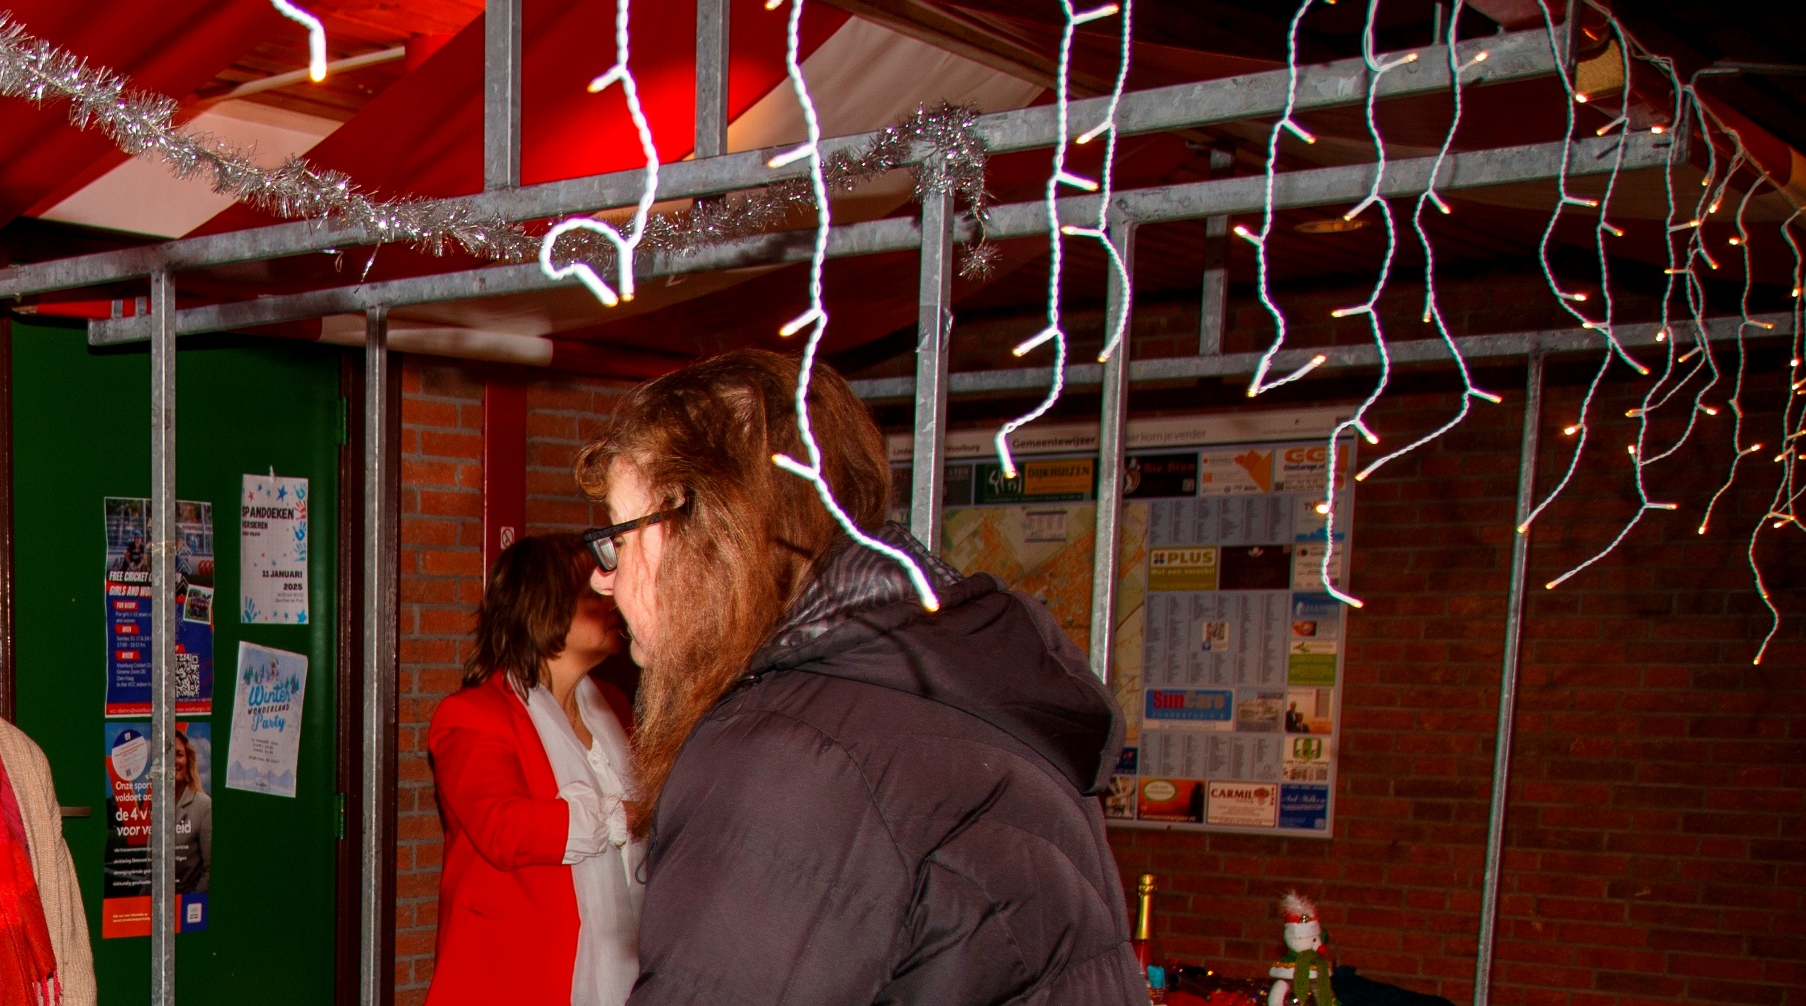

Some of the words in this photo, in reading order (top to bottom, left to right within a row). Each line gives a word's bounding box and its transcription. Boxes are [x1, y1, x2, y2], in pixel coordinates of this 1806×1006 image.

[1167, 551, 1213, 564] PLUS
[109, 570, 124, 581] FREE
[124, 571, 147, 582] CRICKET
[270, 570, 303, 578] JANUARI
[109, 584, 125, 597] GIRLS
[125, 586, 139, 597] AND
[283, 582, 303, 591] 2025
[248, 684, 292, 707] Winter
[247, 703, 290, 715] WONDERLAND
[251, 712, 286, 732] Party
[115, 781, 133, 791] Onze
[115, 793, 141, 802] voldoet
[115, 808, 128, 821] de
[129, 809, 139, 820] 4
[117, 825, 141, 836] voor
